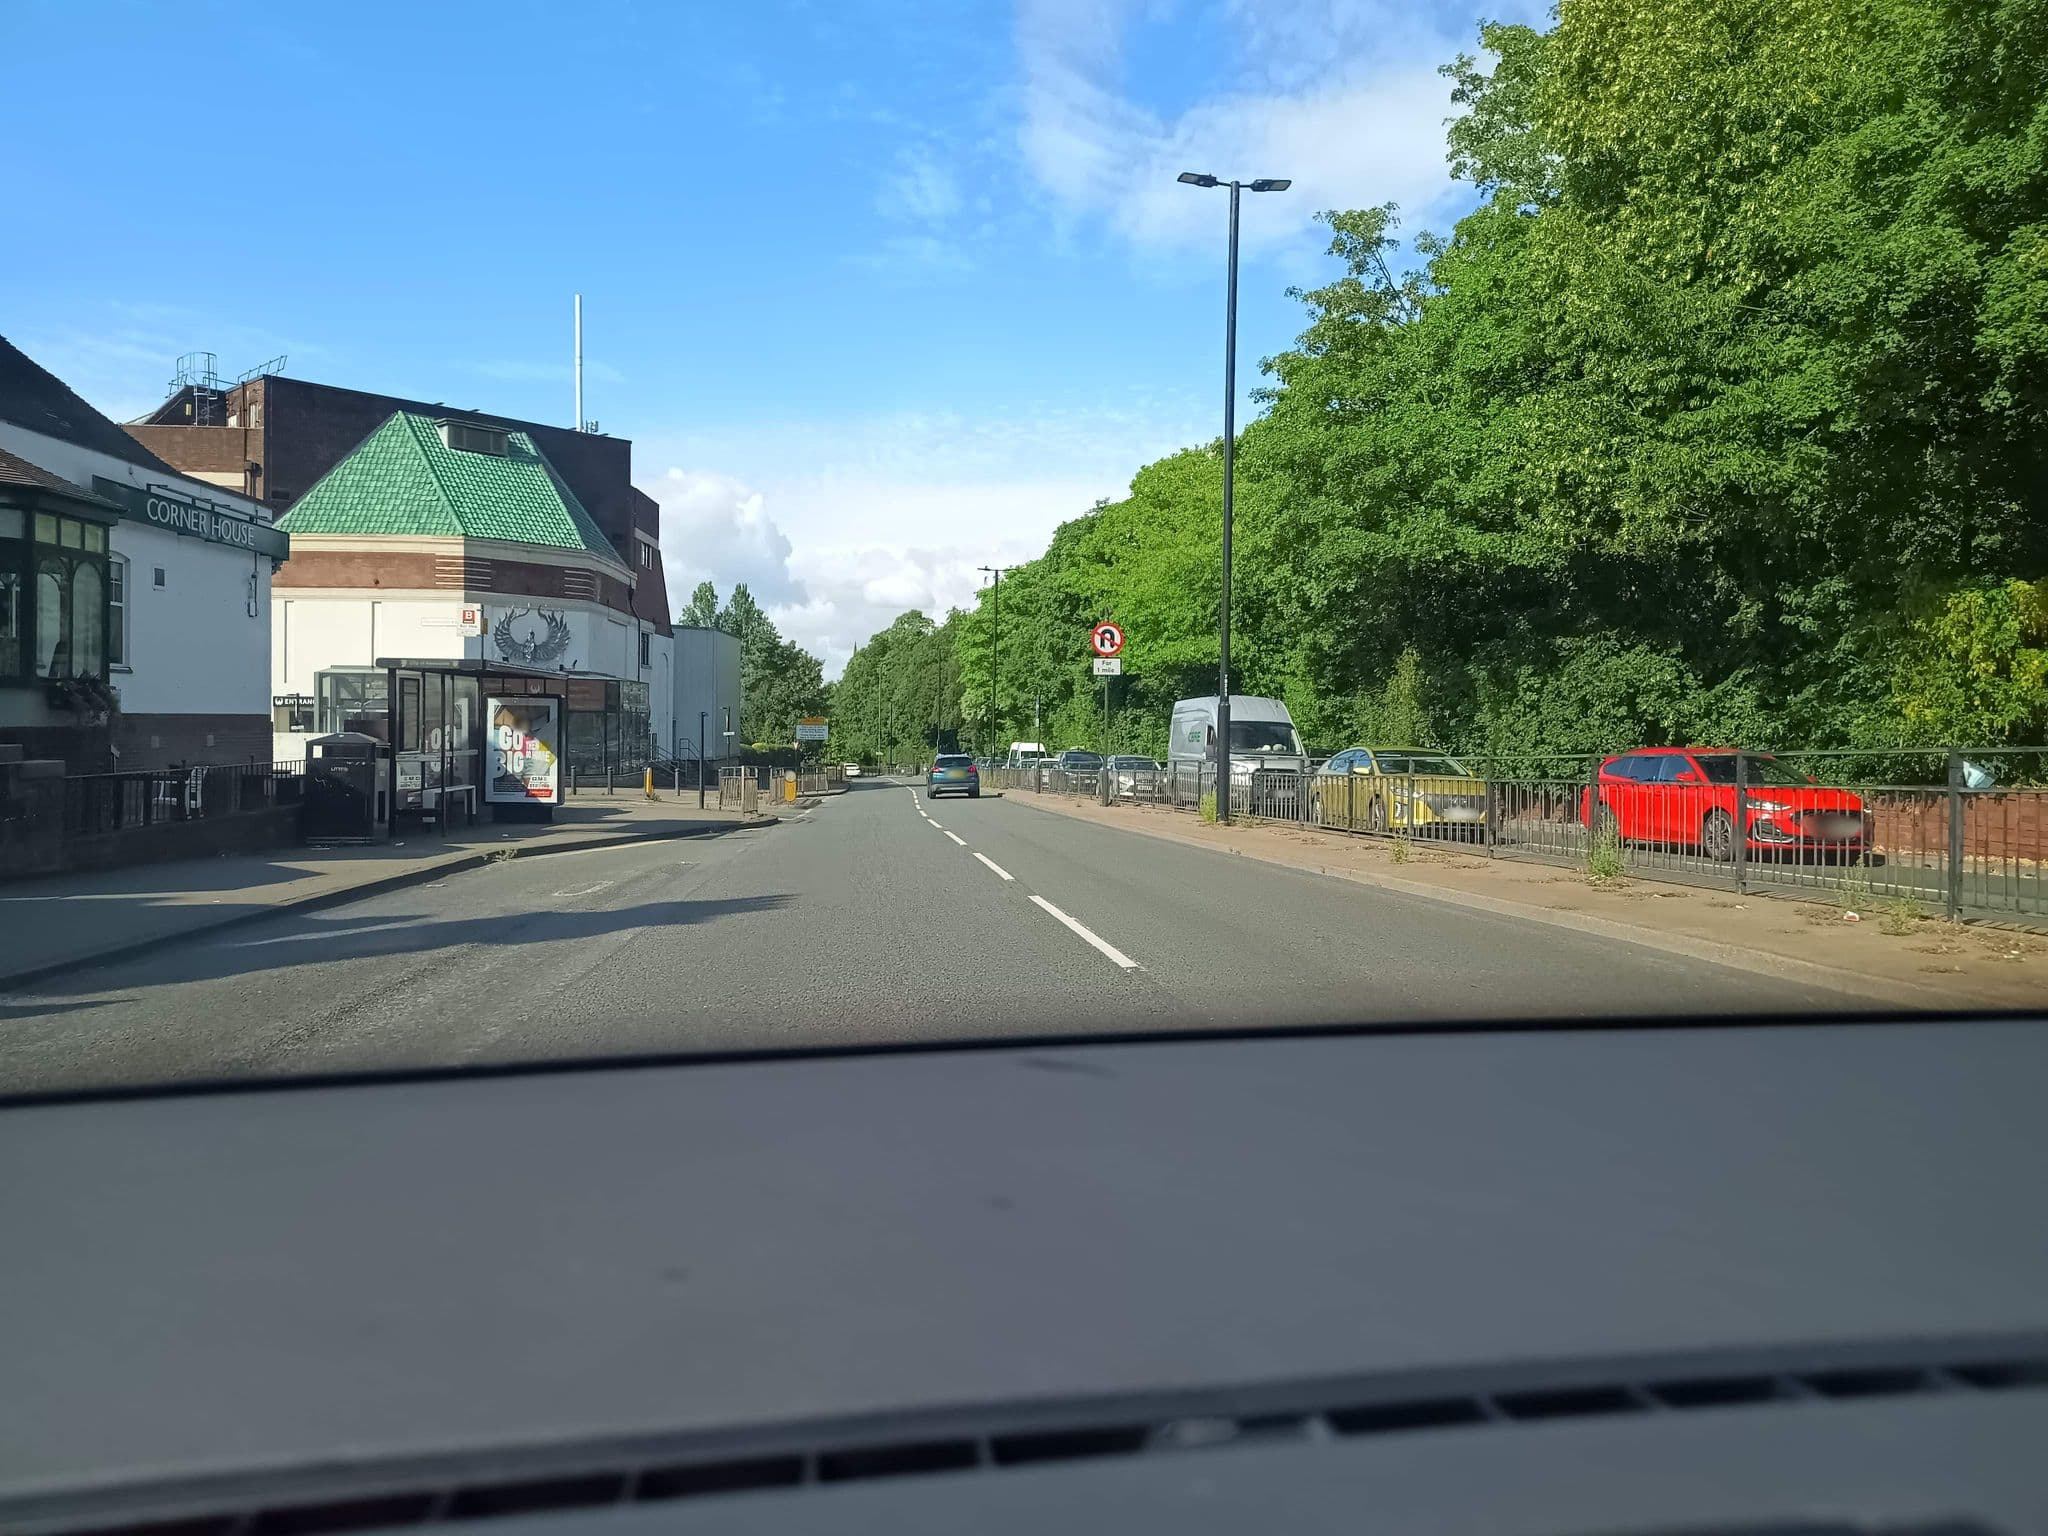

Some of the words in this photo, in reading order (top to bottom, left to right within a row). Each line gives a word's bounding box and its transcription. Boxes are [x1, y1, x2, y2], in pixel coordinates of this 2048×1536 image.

[146, 498, 208, 534] CORNER
[211, 515, 255, 546] HOUSE
[499, 725, 524, 751] GO
[493, 750, 525, 779] BIG
